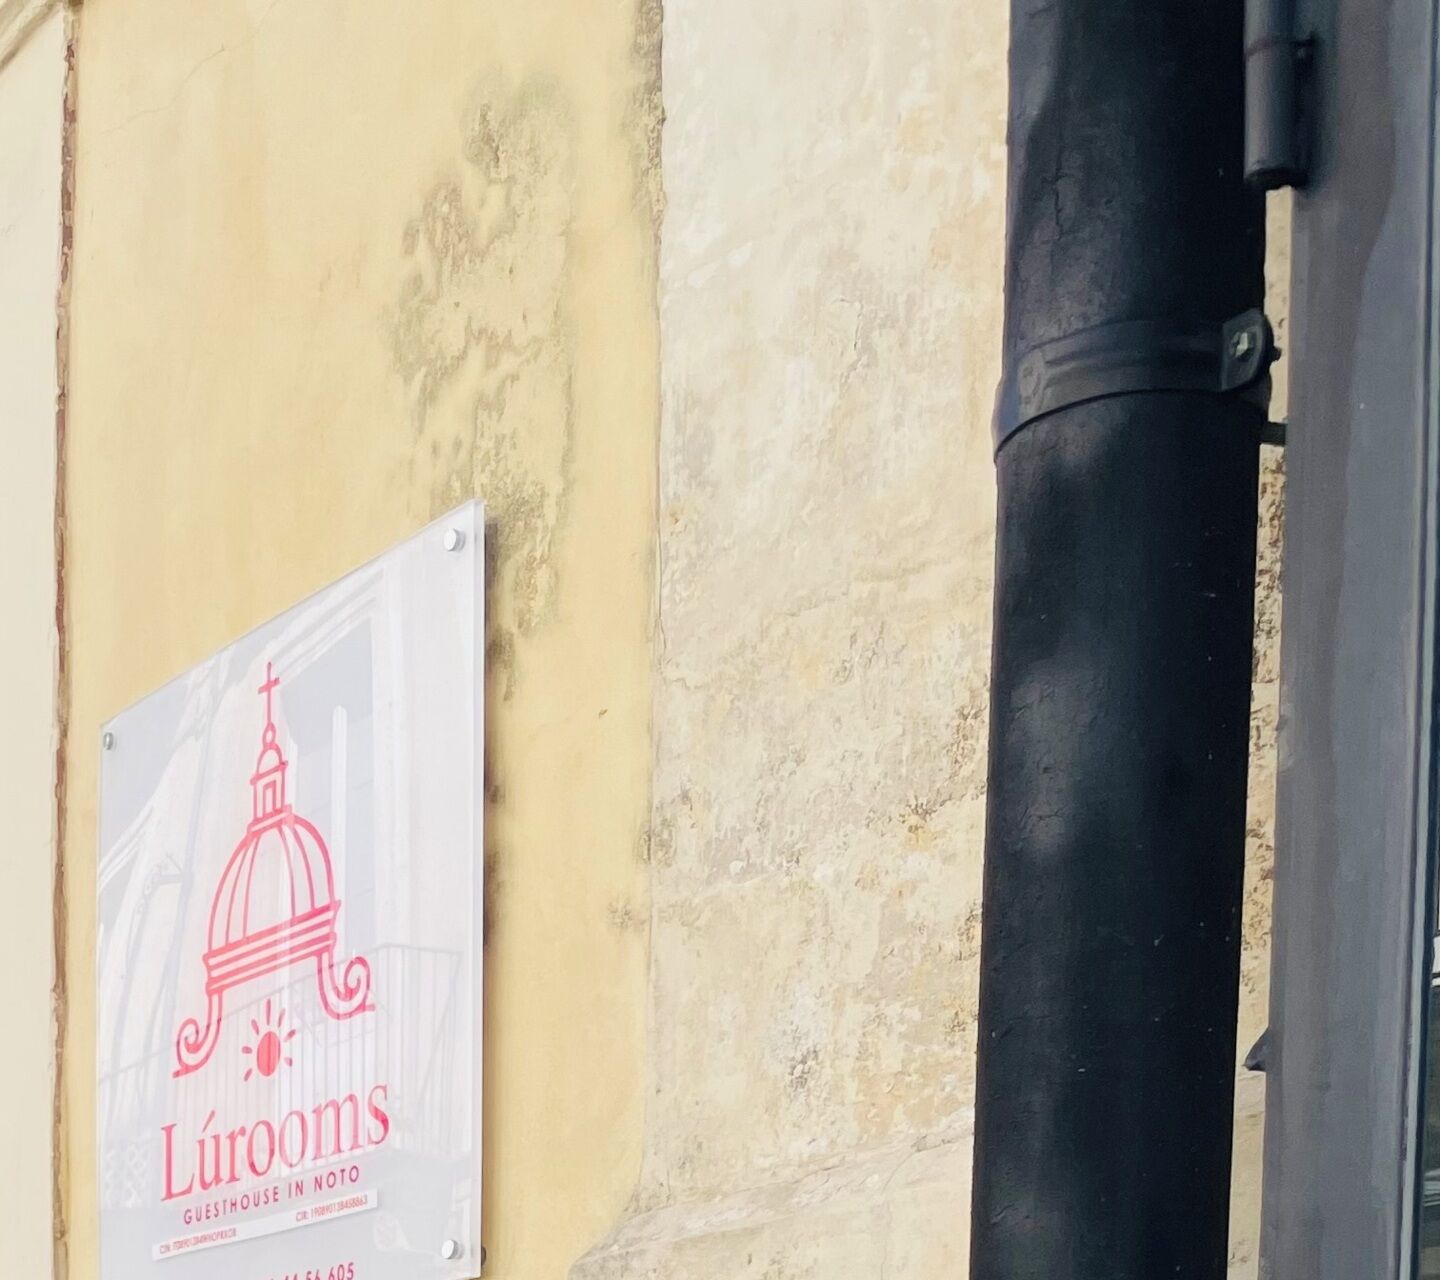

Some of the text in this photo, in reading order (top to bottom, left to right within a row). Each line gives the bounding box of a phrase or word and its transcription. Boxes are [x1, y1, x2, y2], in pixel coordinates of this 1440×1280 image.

[160, 1084, 391, 1202] Lúrooms
[183, 1165, 359, 1225] GUESTHOUSE IN NOTO
